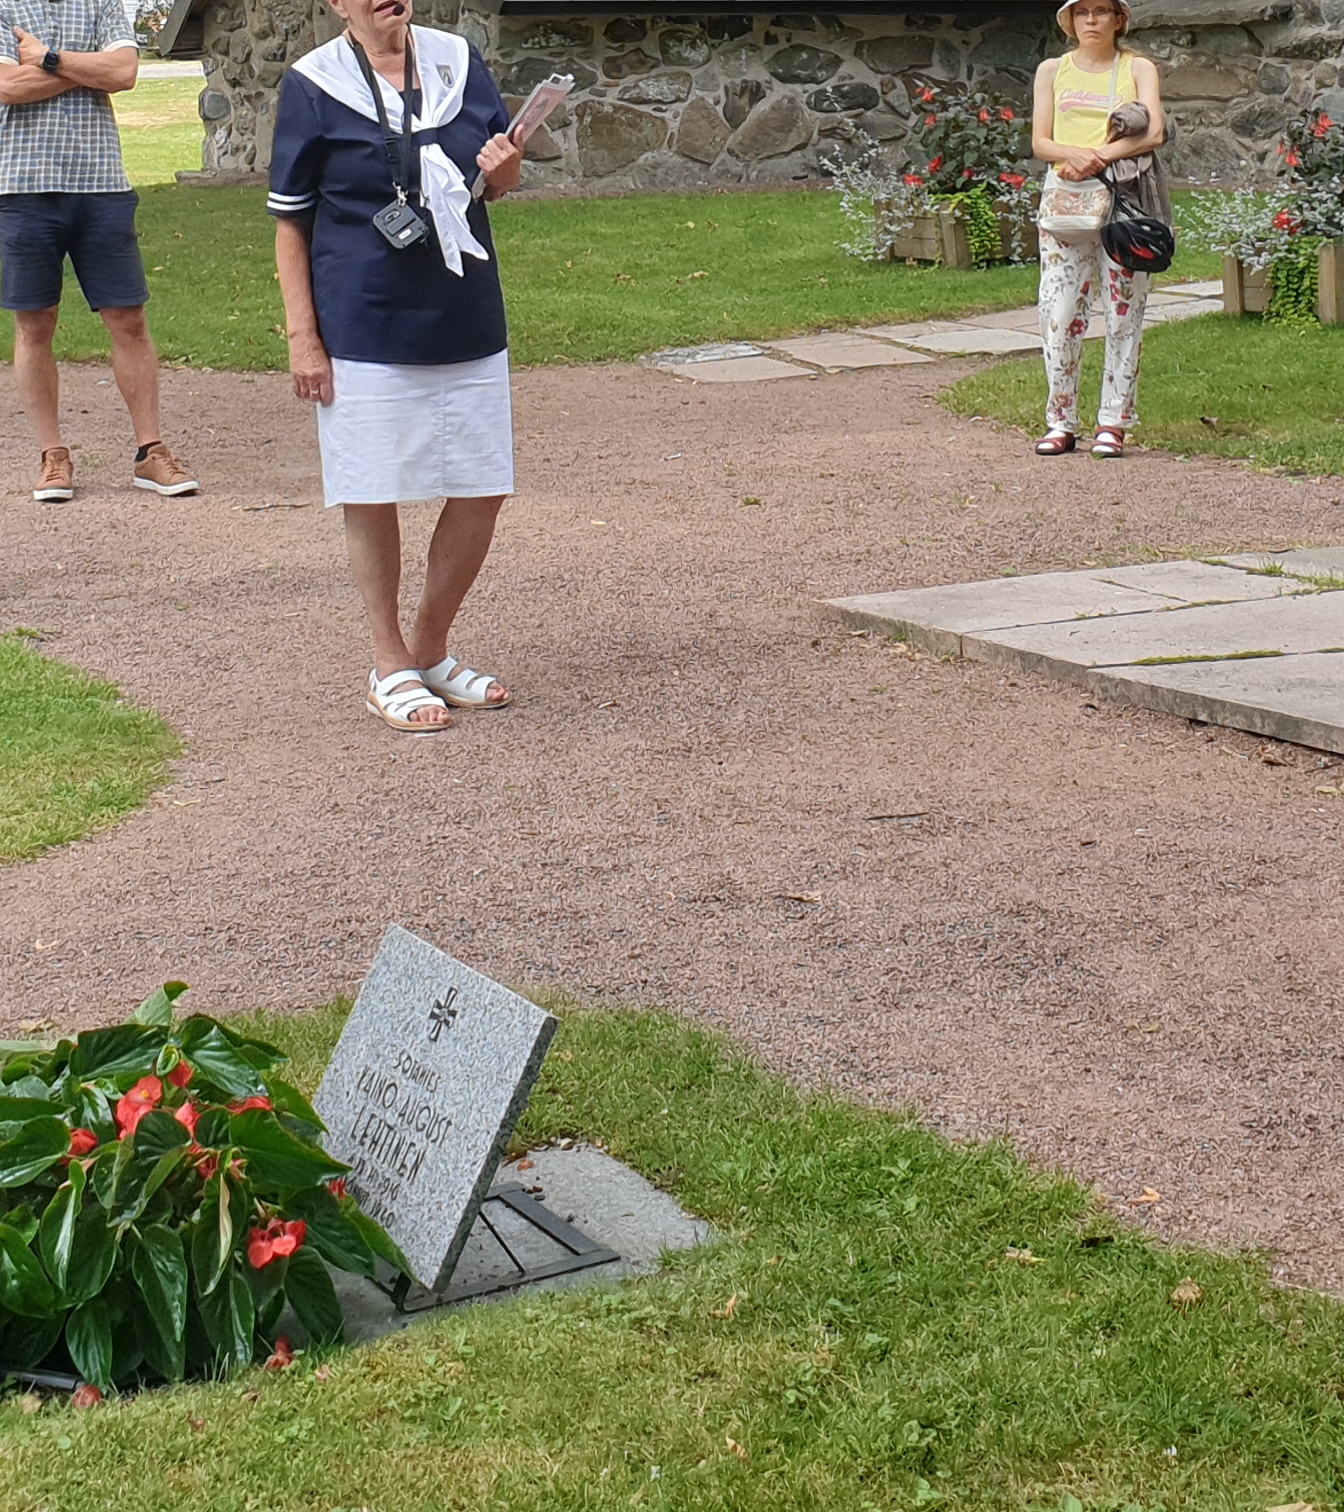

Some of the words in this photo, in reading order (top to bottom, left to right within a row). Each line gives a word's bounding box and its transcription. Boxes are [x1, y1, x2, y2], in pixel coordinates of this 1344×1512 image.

[1059, 88, 1123, 104] Californa
[394, 1049, 441, 1093] SOTAMIES
[351, 1105, 427, 1184] LEHTINEN
[398, 1095, 452, 1148] AUGUST
